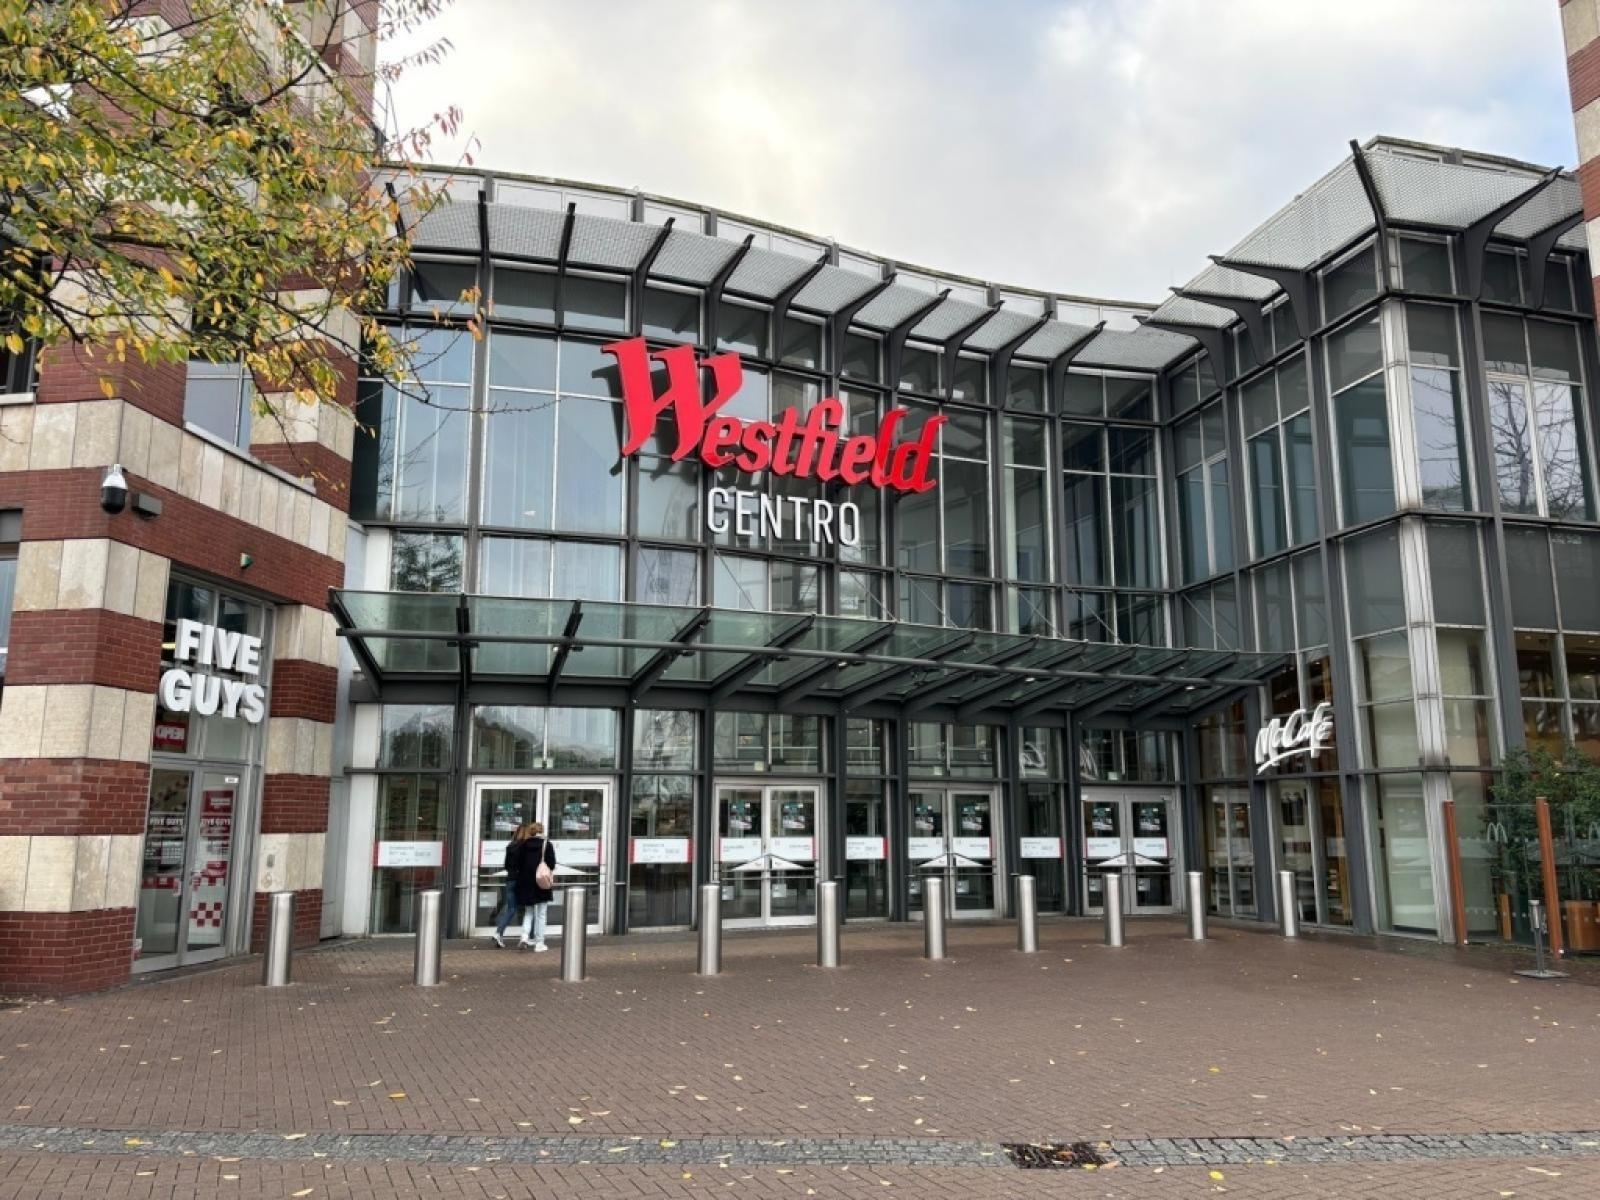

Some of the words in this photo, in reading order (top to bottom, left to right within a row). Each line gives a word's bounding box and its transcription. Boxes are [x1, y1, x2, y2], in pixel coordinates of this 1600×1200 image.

[602, 336, 949, 495] Westfield
[707, 487, 861, 546] CENTRO
[174, 618, 262, 675] FIVE
[159, 669, 265, 724] GUYS
[156, 725, 185, 740] OPEN
